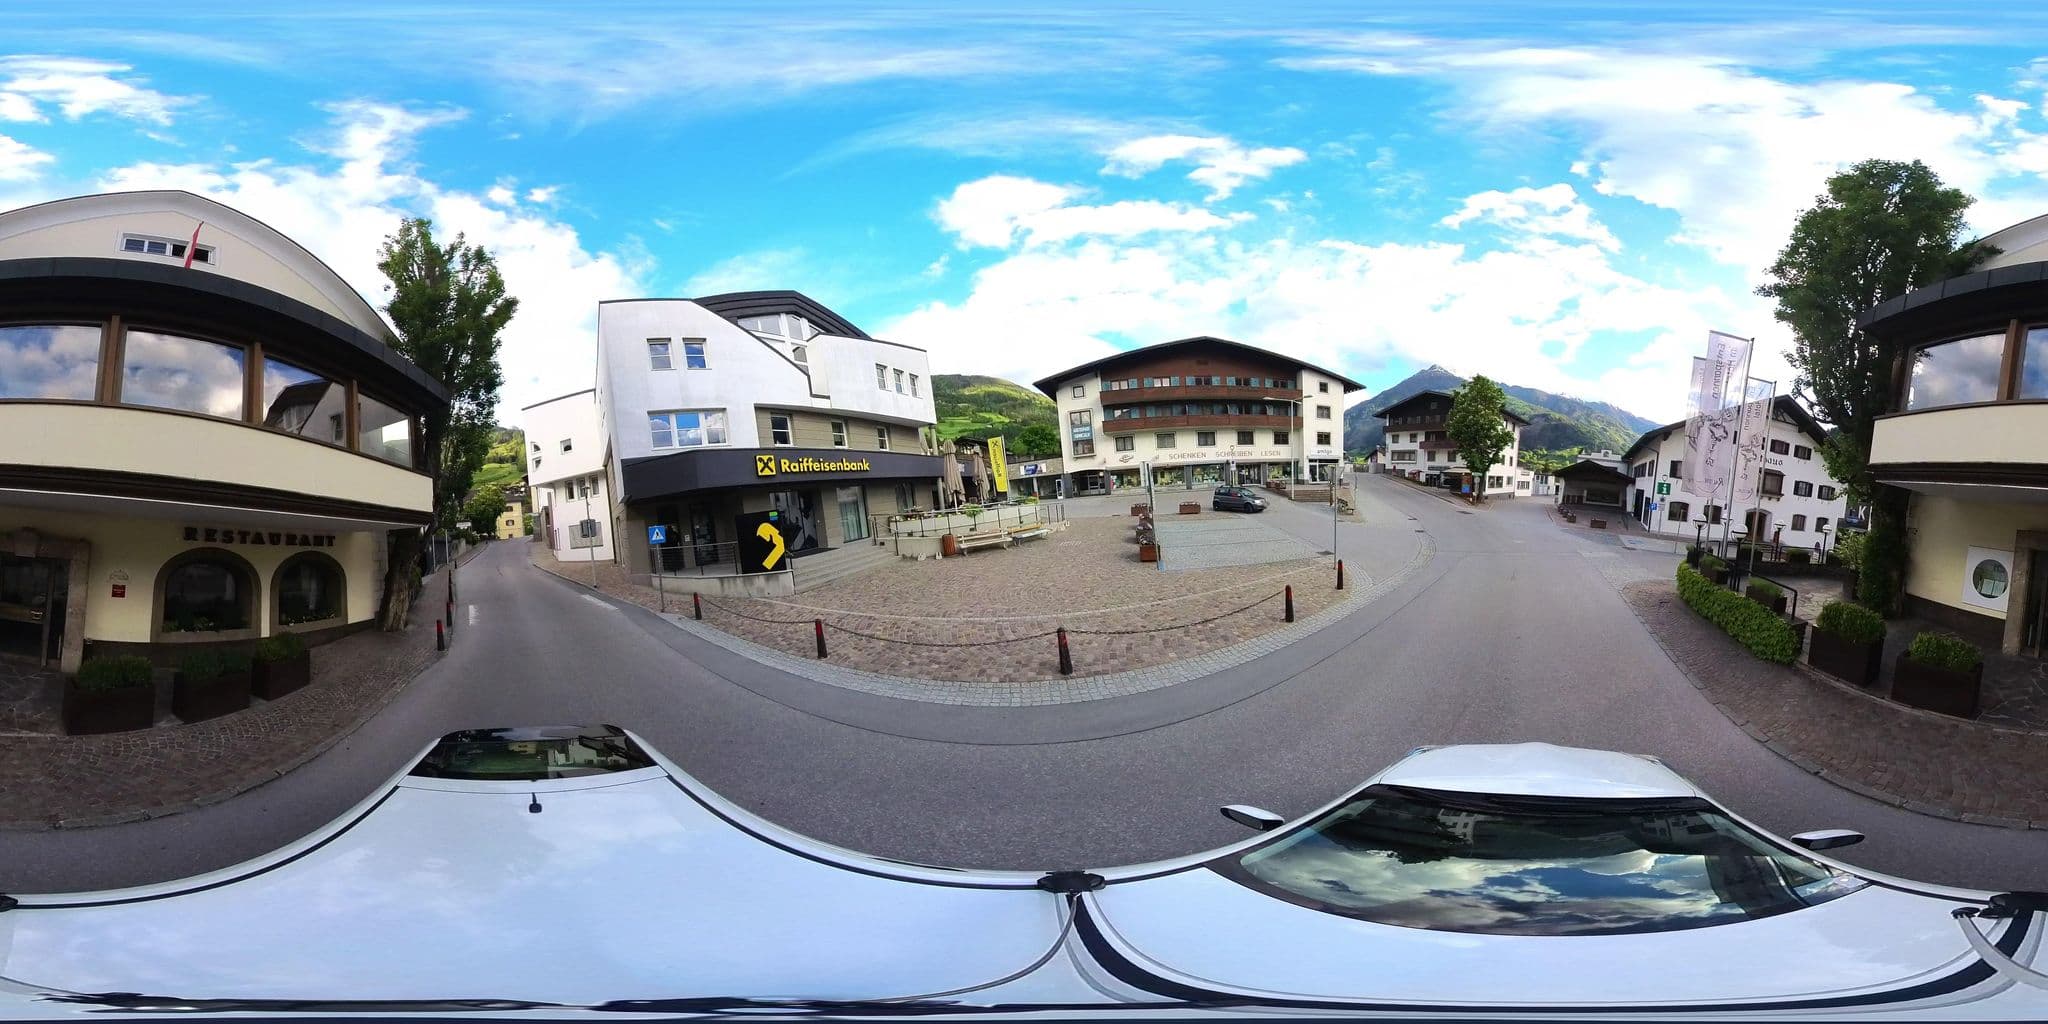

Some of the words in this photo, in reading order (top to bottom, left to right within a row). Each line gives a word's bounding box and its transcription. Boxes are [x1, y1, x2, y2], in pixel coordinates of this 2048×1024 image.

[1168, 451, 1207, 460] SCHENKEN
[1260, 449, 1281, 457] LESEN
[780, 457, 870, 473] Raiffeisenbank
[183, 526, 336, 547] RESTAURANT
